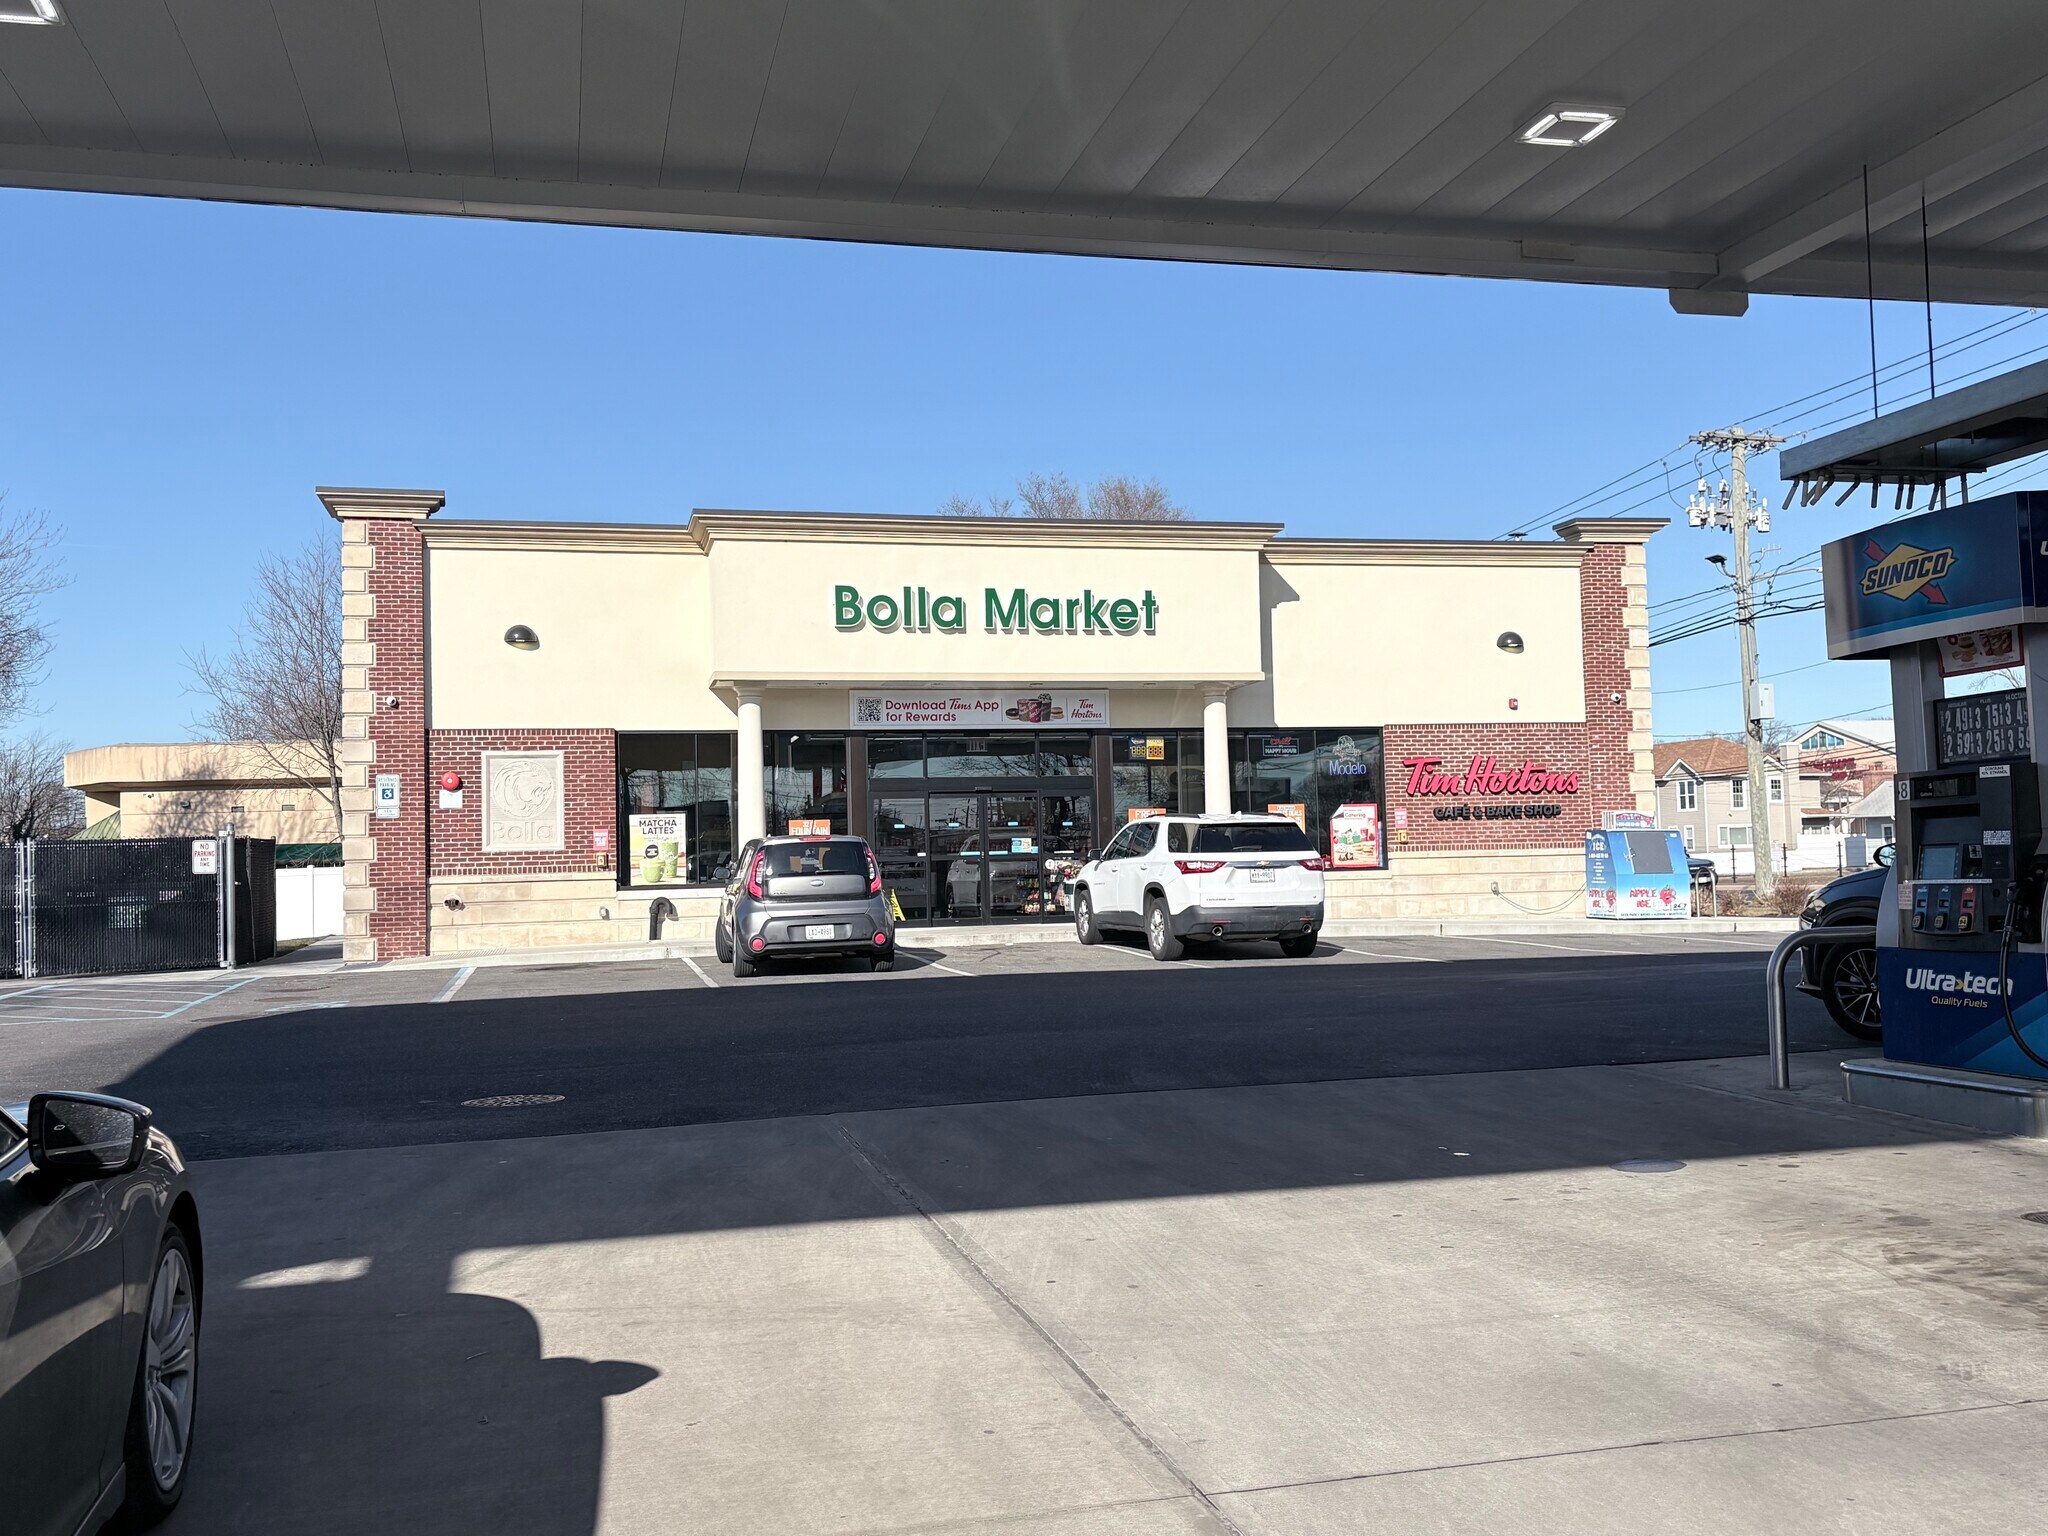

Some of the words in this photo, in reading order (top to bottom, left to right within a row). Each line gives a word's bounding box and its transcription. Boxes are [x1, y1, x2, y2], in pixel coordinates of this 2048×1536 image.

[1865, 551, 1949, 591] SUNOCO
[834, 584, 965, 631] Bolla
[984, 587, 1157, 634] Market
[885, 700, 946, 710] Download
[949, 698, 972, 711] Tims
[974, 700, 999, 712] App
[1079, 699, 1094, 709] Tim
[886, 712, 902, 722] for
[906, 712, 957, 722] Rewards
[1071, 709, 1102, 719] Hortons
[1329, 760, 1367, 776] Modelo
[1402, 757, 1460, 797] Tim
[1463, 755, 1579, 796] Hortons
[1901, 782, 1908, 799] 8
[1434, 804, 1471, 821] CAFÉ
[1473, 807, 1484, 820] &
[1485, 805, 1525, 820] BAKE
[1525, 804, 1563, 819] SHOP
[638, 819, 677, 828] MATCHA
[493, 821, 553, 842] Bolla
[642, 826, 675, 835] LATTES
[1592, 841, 1605, 851] ICE
[194, 850, 216, 858] PARKING
[1588, 889, 1605, 898] APPLE
[1629, 888, 1657, 898] APPLE
[1592, 899, 1602, 908] ICE
[1636, 899, 1651, 908] ICE
[1931, 996, 1963, 1008] Quality
[1964, 998, 1988, 1009] Fuels
